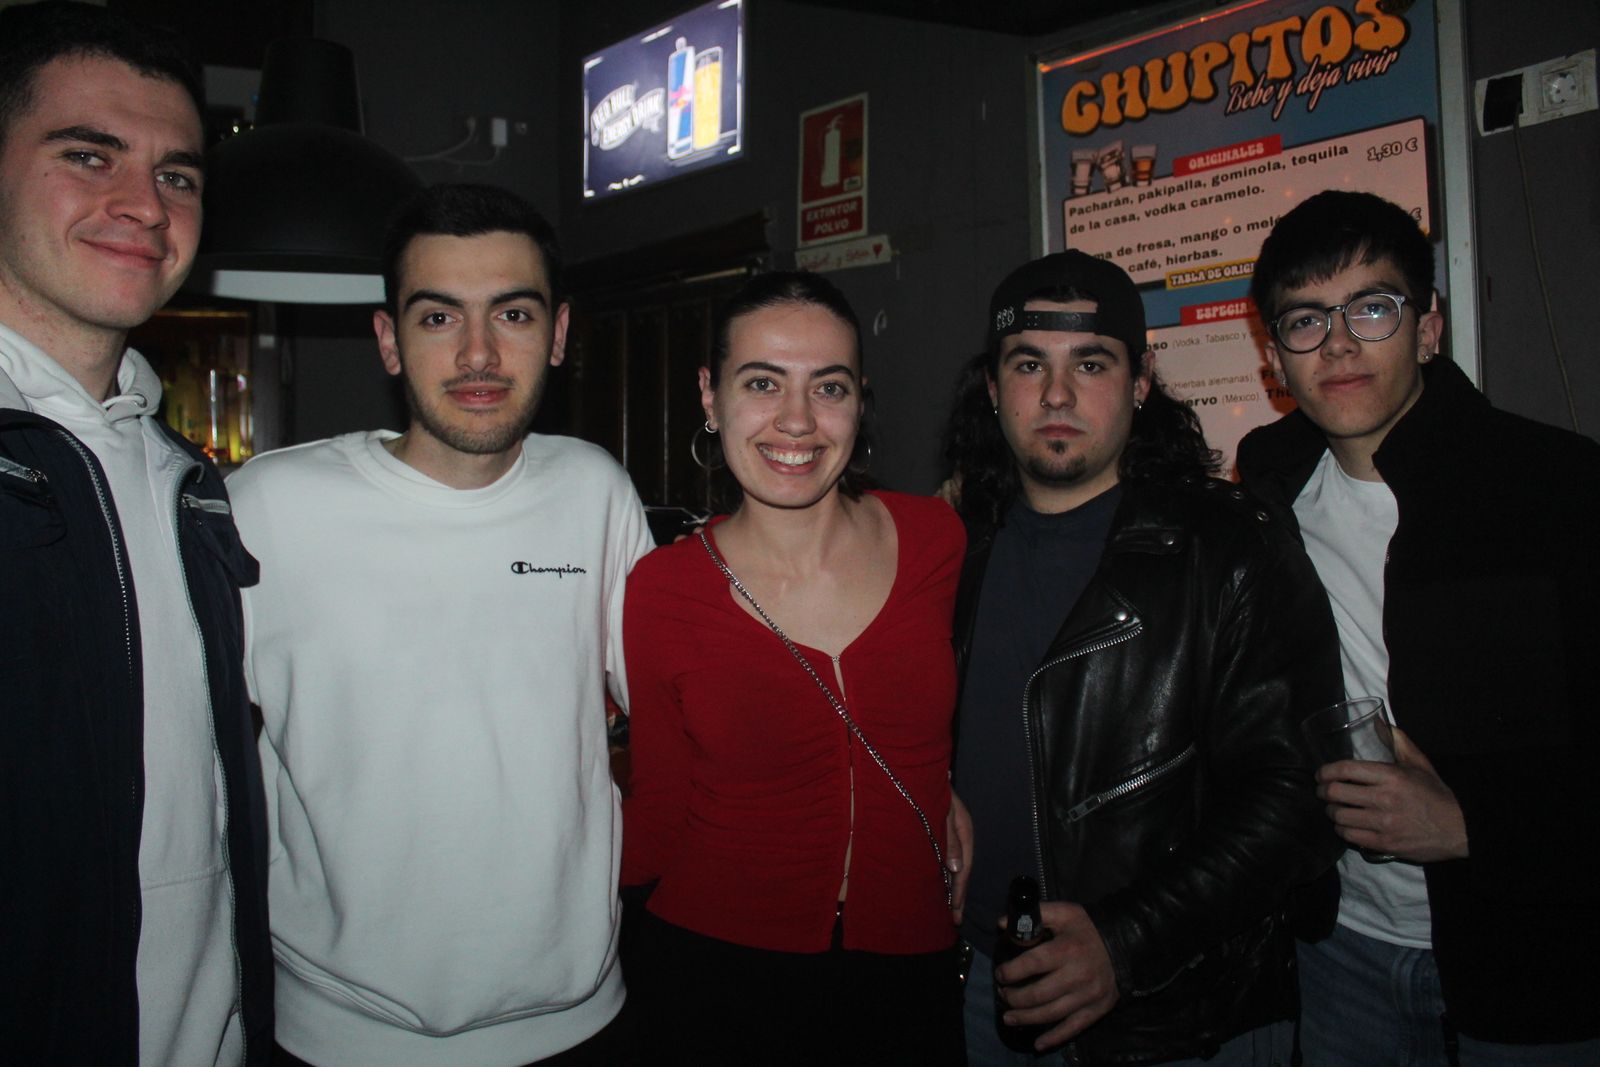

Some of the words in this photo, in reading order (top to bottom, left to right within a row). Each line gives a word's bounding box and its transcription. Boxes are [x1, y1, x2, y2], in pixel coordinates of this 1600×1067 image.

[1061, 0, 1407, 134] CHUPITOS
[1226, 73, 1275, 115] Bebe
[1272, 80, 1294, 119] y
[1296, 54, 1343, 112] deja
[1347, 48, 1399, 82] vivir
[1188, 142, 1265, 170] ORIGINALES
[1069, 195, 1134, 217] Pacharán,
[1138, 179, 1207, 204] pakipalla,
[1211, 161, 1287, 188] gominola,
[1292, 145, 1349, 167] tequila
[806, 200, 858, 222] EXTINTOR
[1070, 222, 1085, 235] de
[1089, 220, 1101, 231] la
[1104, 214, 1140, 228] casa,
[1145, 201, 1187, 218] vodka
[1191, 186, 1265, 208] caramelo.
[814, 218, 850, 236] POLVO
[1117, 243, 1133, 257] de
[1137, 240, 1176, 253] fresa,
[1180, 227, 1228, 244] mango
[1233, 225, 1242, 235] o
[1128, 258, 1162, 273] café,
[1166, 248, 1223, 266] hierbas.
[1171, 268, 1206, 286] TABLA
[1207, 266, 1223, 281] DE
[1224, 262, 1255, 278] ORIGI
[1196, 301, 1248, 320] ESPECIA
[1206, 332, 1240, 344] Tabasco
[510, 561, 587, 579] Champion
